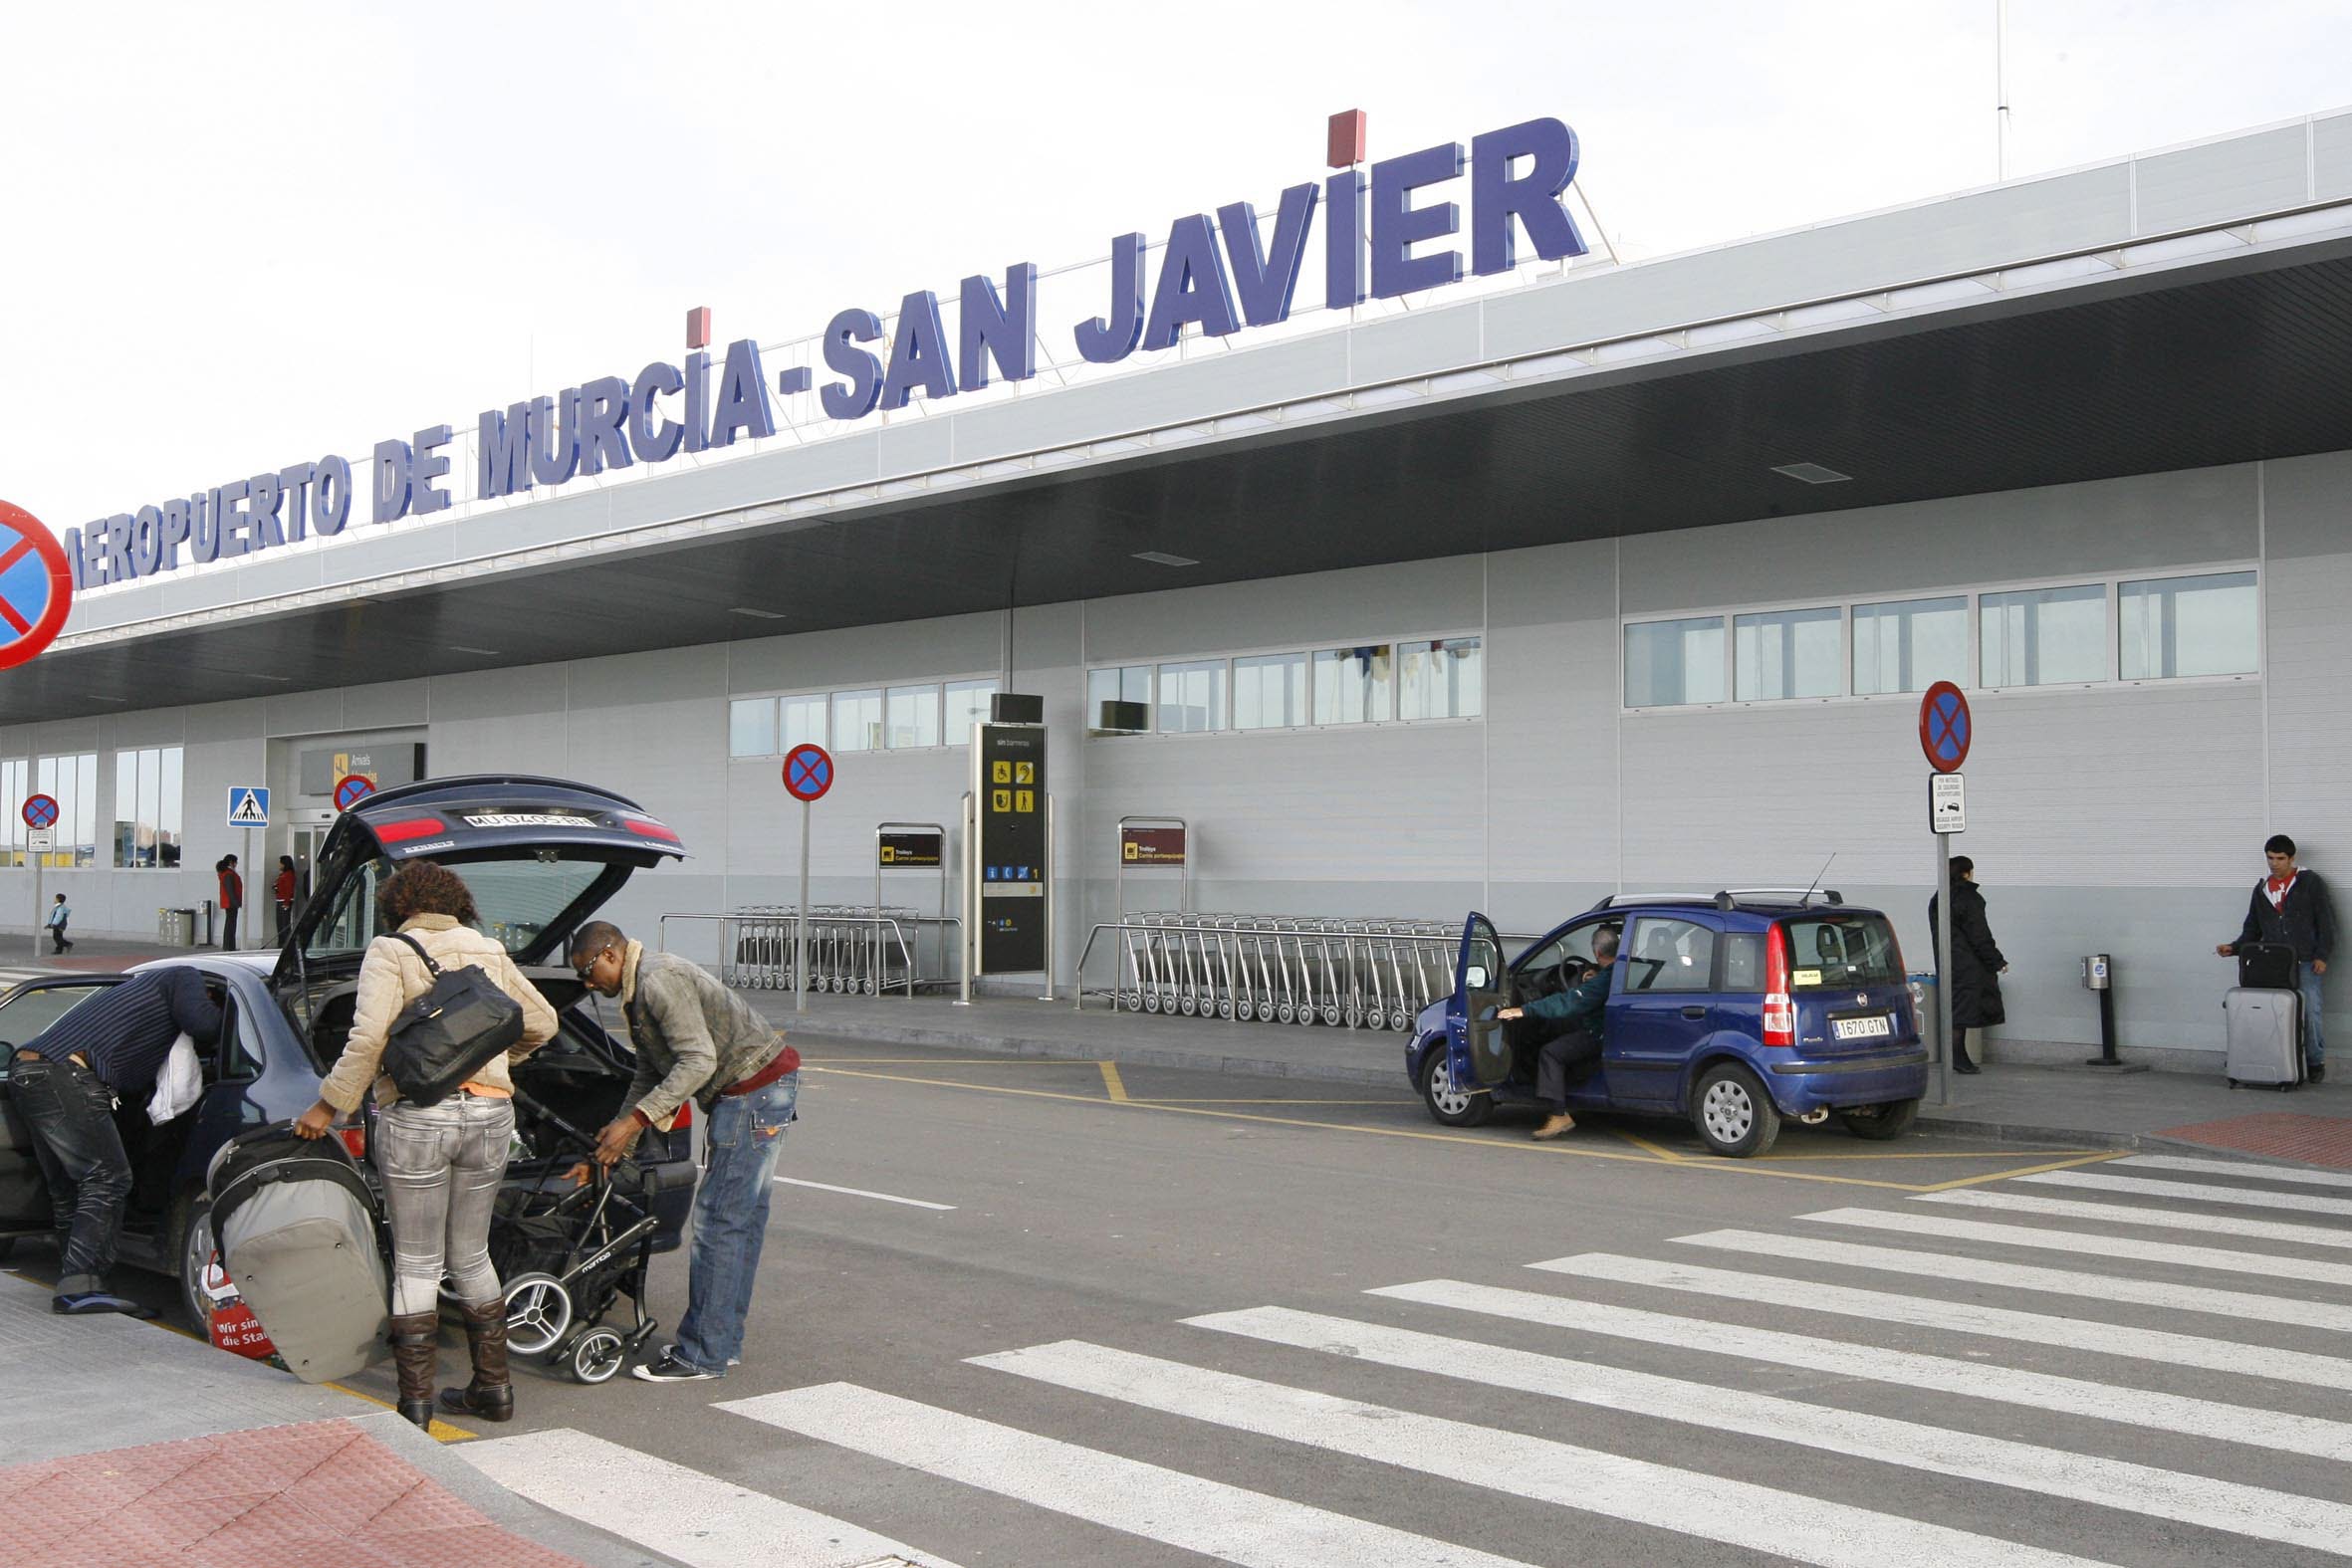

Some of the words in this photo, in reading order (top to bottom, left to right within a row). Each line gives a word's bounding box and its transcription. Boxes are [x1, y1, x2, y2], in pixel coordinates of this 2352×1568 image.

[64, 455, 352, 590] AEROPUERTO
[373, 424, 453, 525] DE
[1840, 1019, 1866, 1036] 1670
[1867, 1017, 1887, 1034] GTN
[217, 1322, 238, 1334] Wir
[222, 1335, 240, 1346] die
